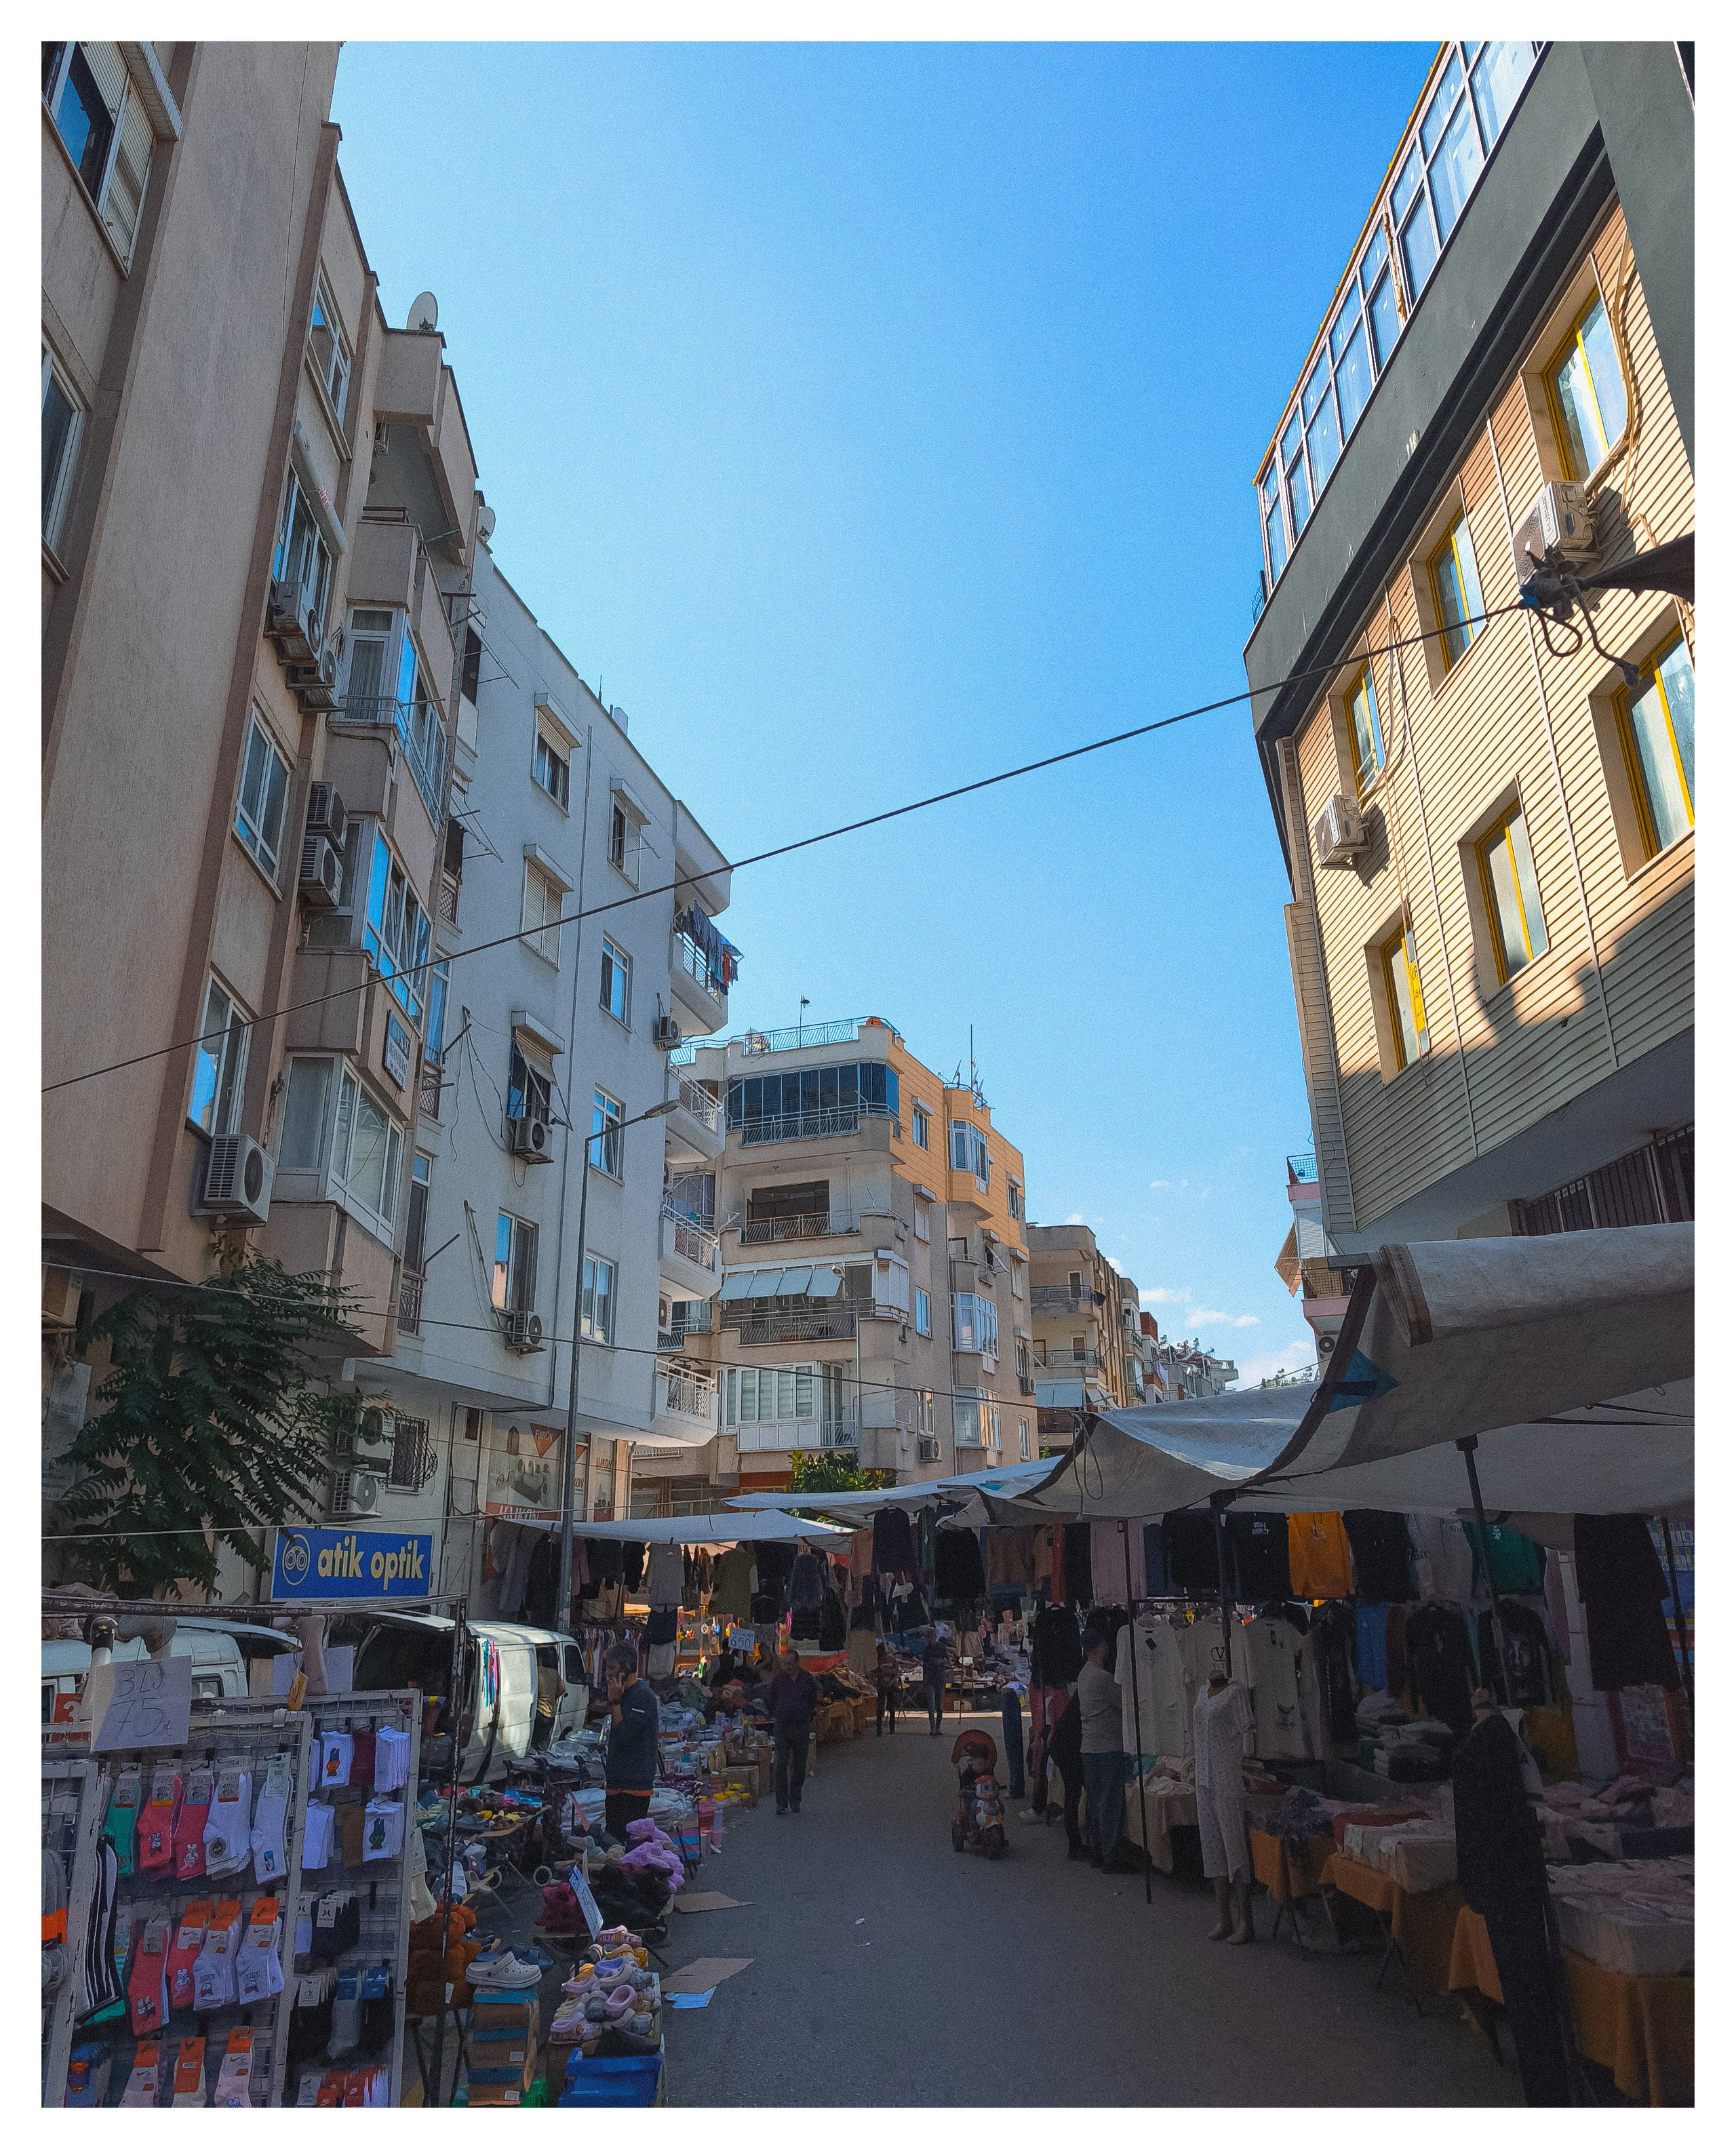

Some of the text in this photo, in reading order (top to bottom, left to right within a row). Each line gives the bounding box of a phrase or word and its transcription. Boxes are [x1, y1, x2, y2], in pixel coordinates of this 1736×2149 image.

[317, 1535, 425, 1591] atik optik
[730, 1636, 751, 1649] 650
